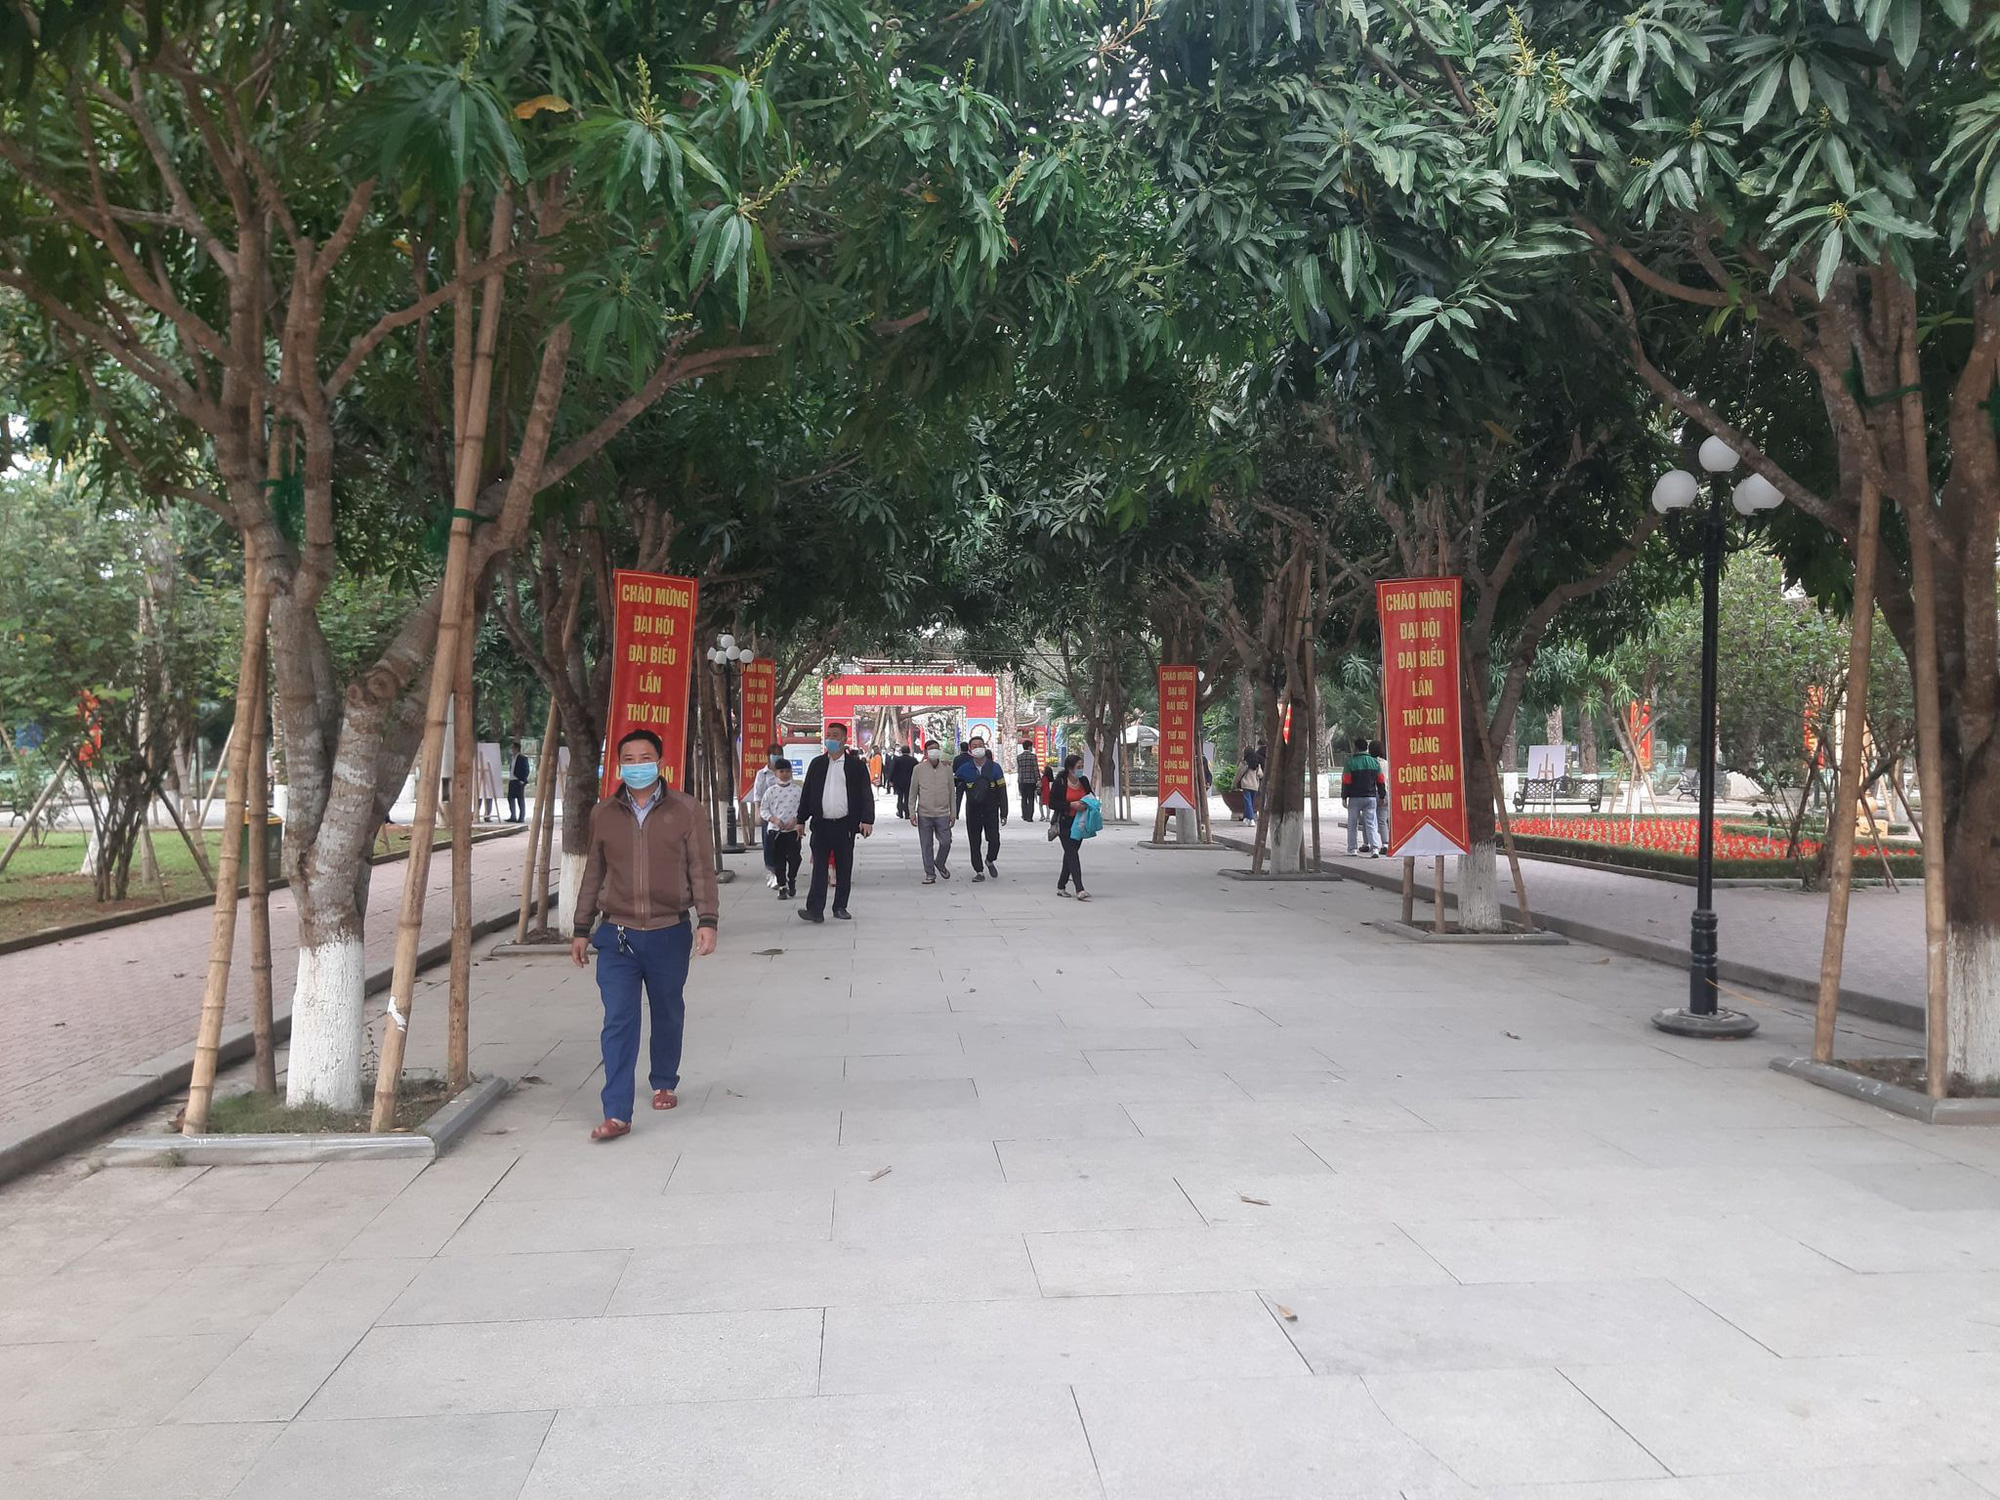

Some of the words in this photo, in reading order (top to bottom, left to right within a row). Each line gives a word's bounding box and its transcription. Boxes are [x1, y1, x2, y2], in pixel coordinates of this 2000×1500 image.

[622, 582, 652, 603] CHÀO
[655, 585, 688, 608] MỪNG
[1385, 589, 1415, 611] CHÀO
[1419, 587, 1452, 609] MỪNG
[633, 615, 652, 636] ĐẠI
[655, 615, 674, 639] HỘI
[1400, 621, 1418, 643] ĐẠI
[1421, 617, 1440, 641] HỘI
[628, 644, 647, 666] ĐẠI
[650, 641, 676, 665] BIỂU
[1398, 651, 1416, 672] ĐẠI
[1420, 643, 1444, 667] BIỂU
[640, 670, 661, 693] LẦN
[1412, 673, 1432, 696] LẦN
[627, 702, 650, 722] THỨ
[651, 705, 670, 724] XIII
[1402, 706, 1423, 726] THỨ
[1426, 707, 1445, 724] XIII
[1409, 732, 1439, 754] ĐẢNG
[1398, 763, 1427, 787] CỘNG
[1430, 759, 1454, 781] SẢN
[1401, 791, 1424, 813] VIỆT
[1427, 792, 1453, 810] NAM
